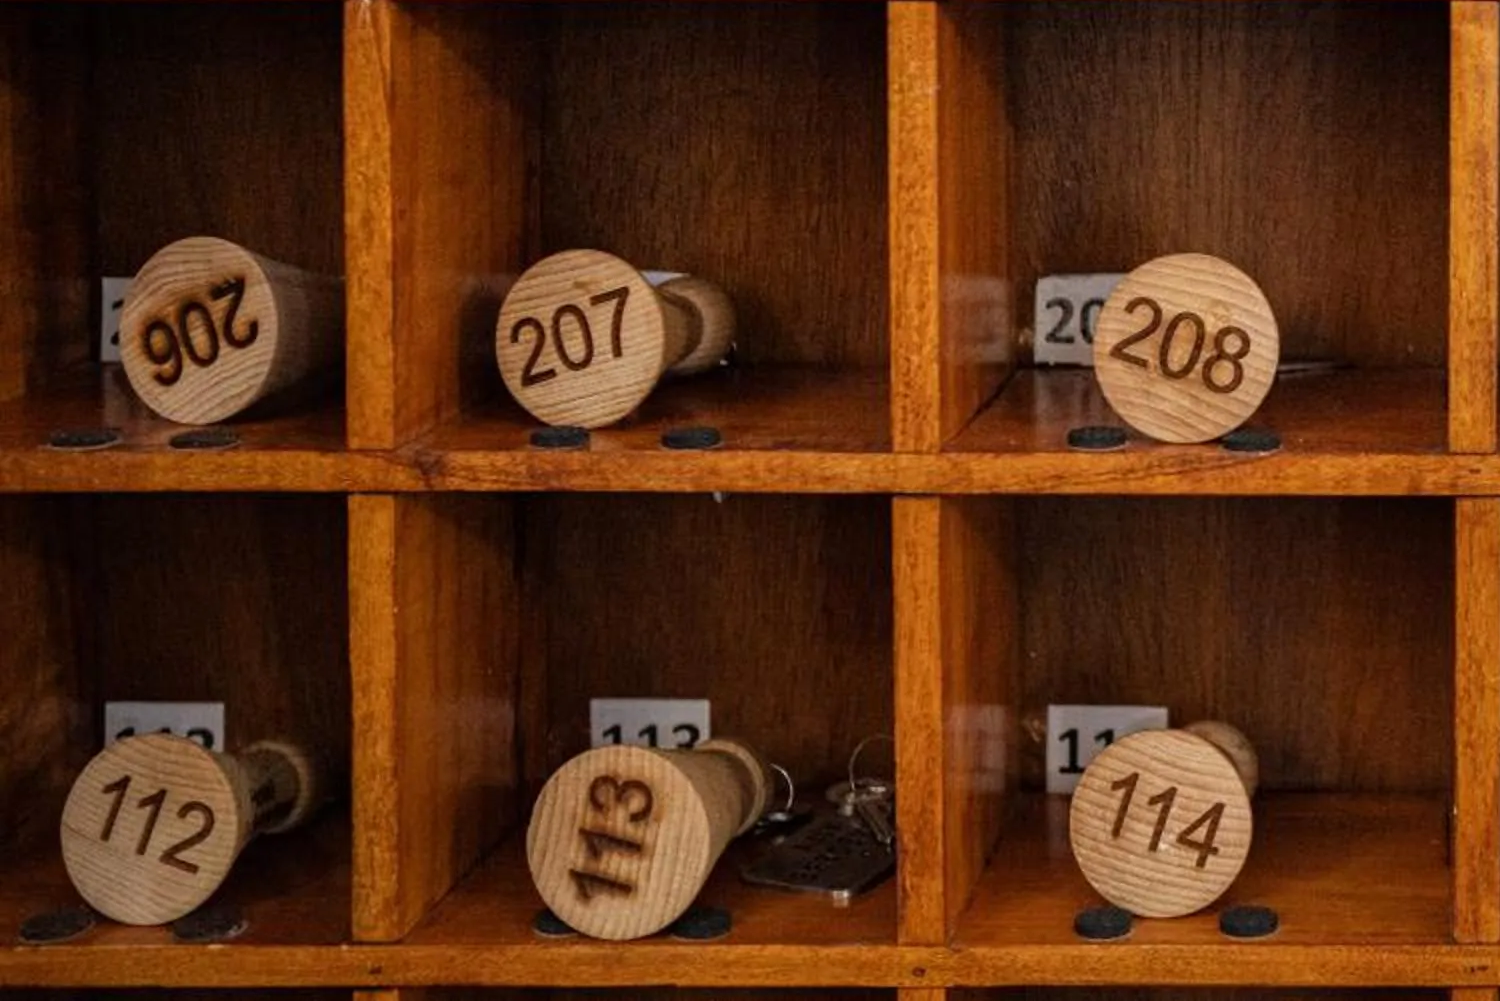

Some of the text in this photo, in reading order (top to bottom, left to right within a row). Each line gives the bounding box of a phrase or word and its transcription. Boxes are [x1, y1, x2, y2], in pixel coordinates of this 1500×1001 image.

[142, 276, 258, 386] 206
[510, 286, 630, 387] 207
[1045, 297, 1104, 344] 20
[1110, 297, 1250, 394] 208
[100, 774, 215, 875] 112
[569, 775, 654, 903] 113
[1111, 772, 1226, 868] 114
